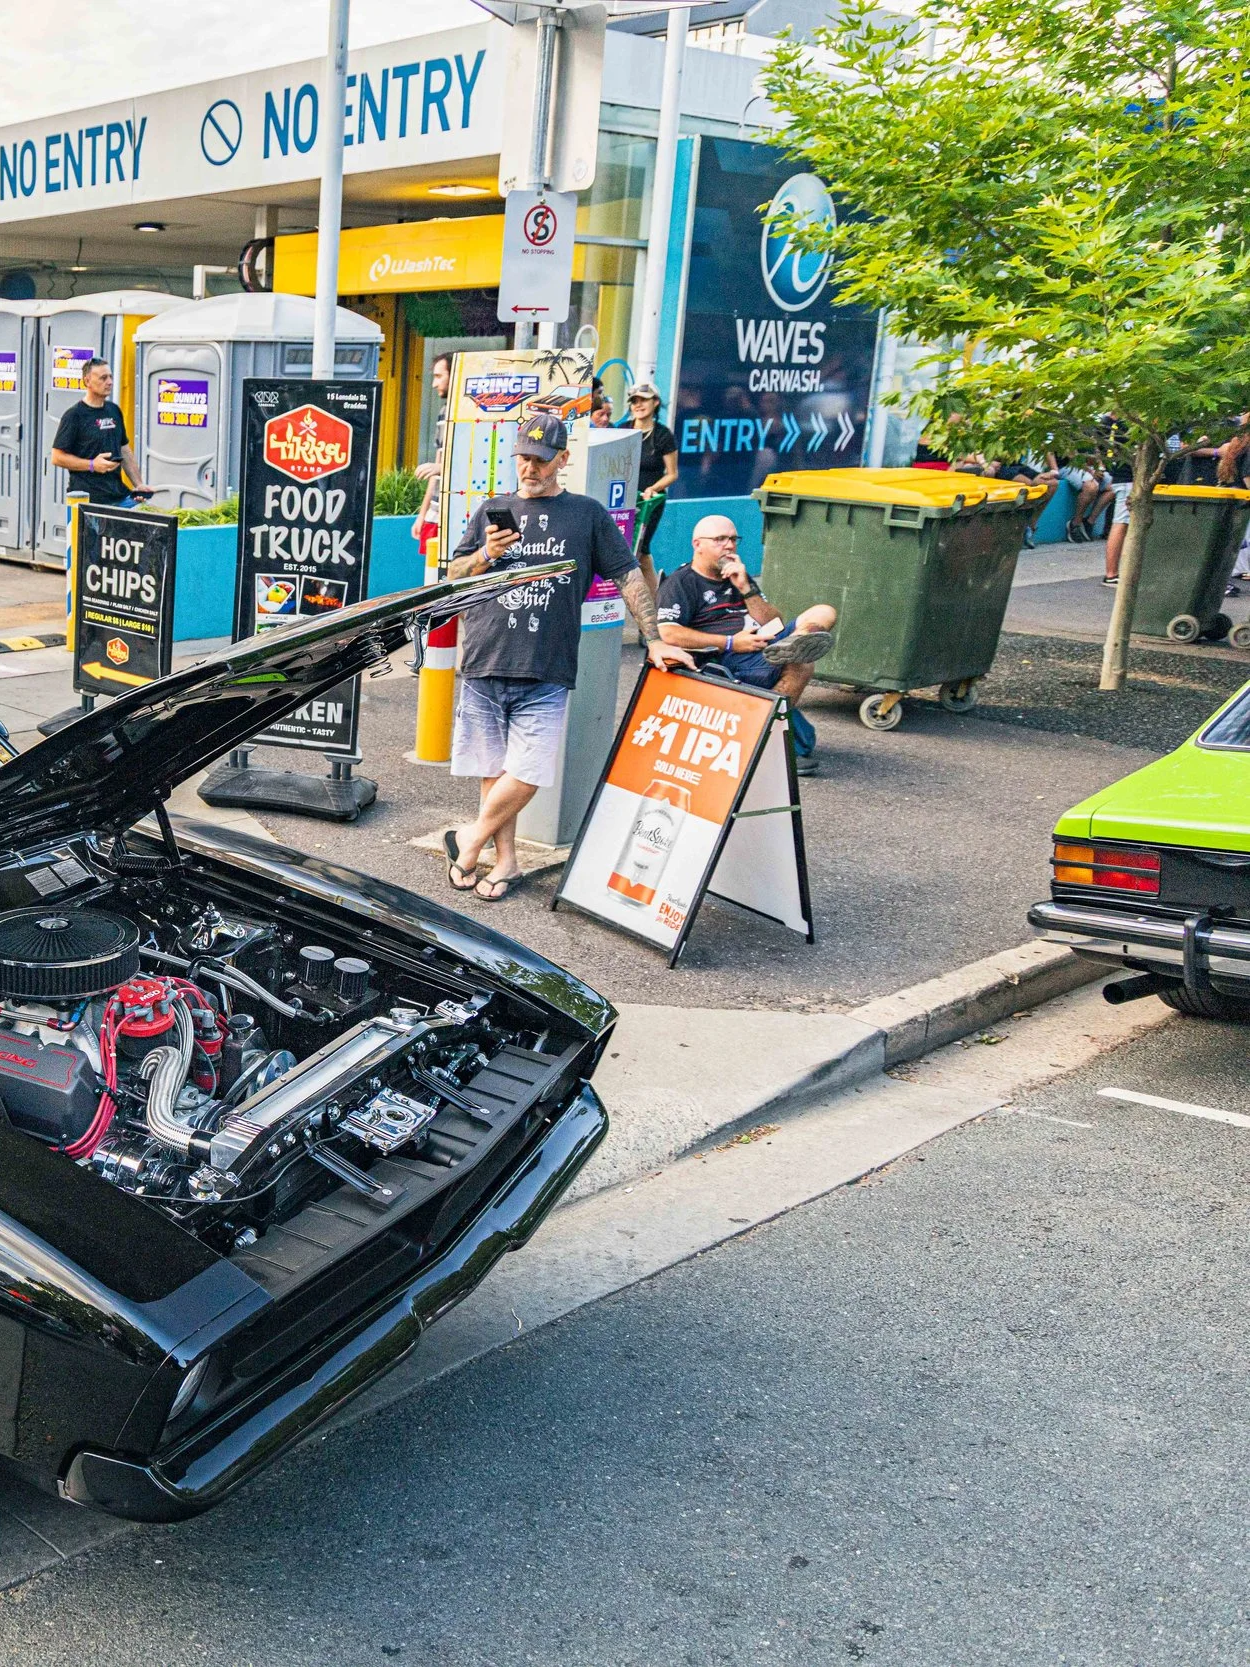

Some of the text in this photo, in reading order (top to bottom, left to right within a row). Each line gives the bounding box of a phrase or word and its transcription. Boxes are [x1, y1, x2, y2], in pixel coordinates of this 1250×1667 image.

[263, 49, 487, 159] NO ENTRY
[0, 117, 147, 201] NO ENTRY
[391, 255, 456, 275] WashTec
[531, 248, 555, 256] STOPPING
[736, 318, 827, 364] WAVES
[466, 376, 538, 394] FRINGE
[680, 417, 775, 454] ENTRY
[264, 484, 347, 524] FOOD
[610, 483, 624, 507] P
[100, 536, 144, 565] HOT
[249, 523, 356, 566] TRUCK
[283, 563, 317, 572] EST. 2015
[85, 564, 157, 603] CHIPS
[497, 585, 555, 612] Chief
[88, 611, 113, 622] REGULAR
[122, 619, 141, 630] LARGE
[658, 694, 742, 736] AUSTRALIA'S
[312, 728, 336, 737] TASTY
[631, 714, 742, 778] #1 IPA
[653, 759, 703, 786] SOLD HERE
[663, 919, 682, 931] RIDE
[139, 989, 161, 1002] MSD
